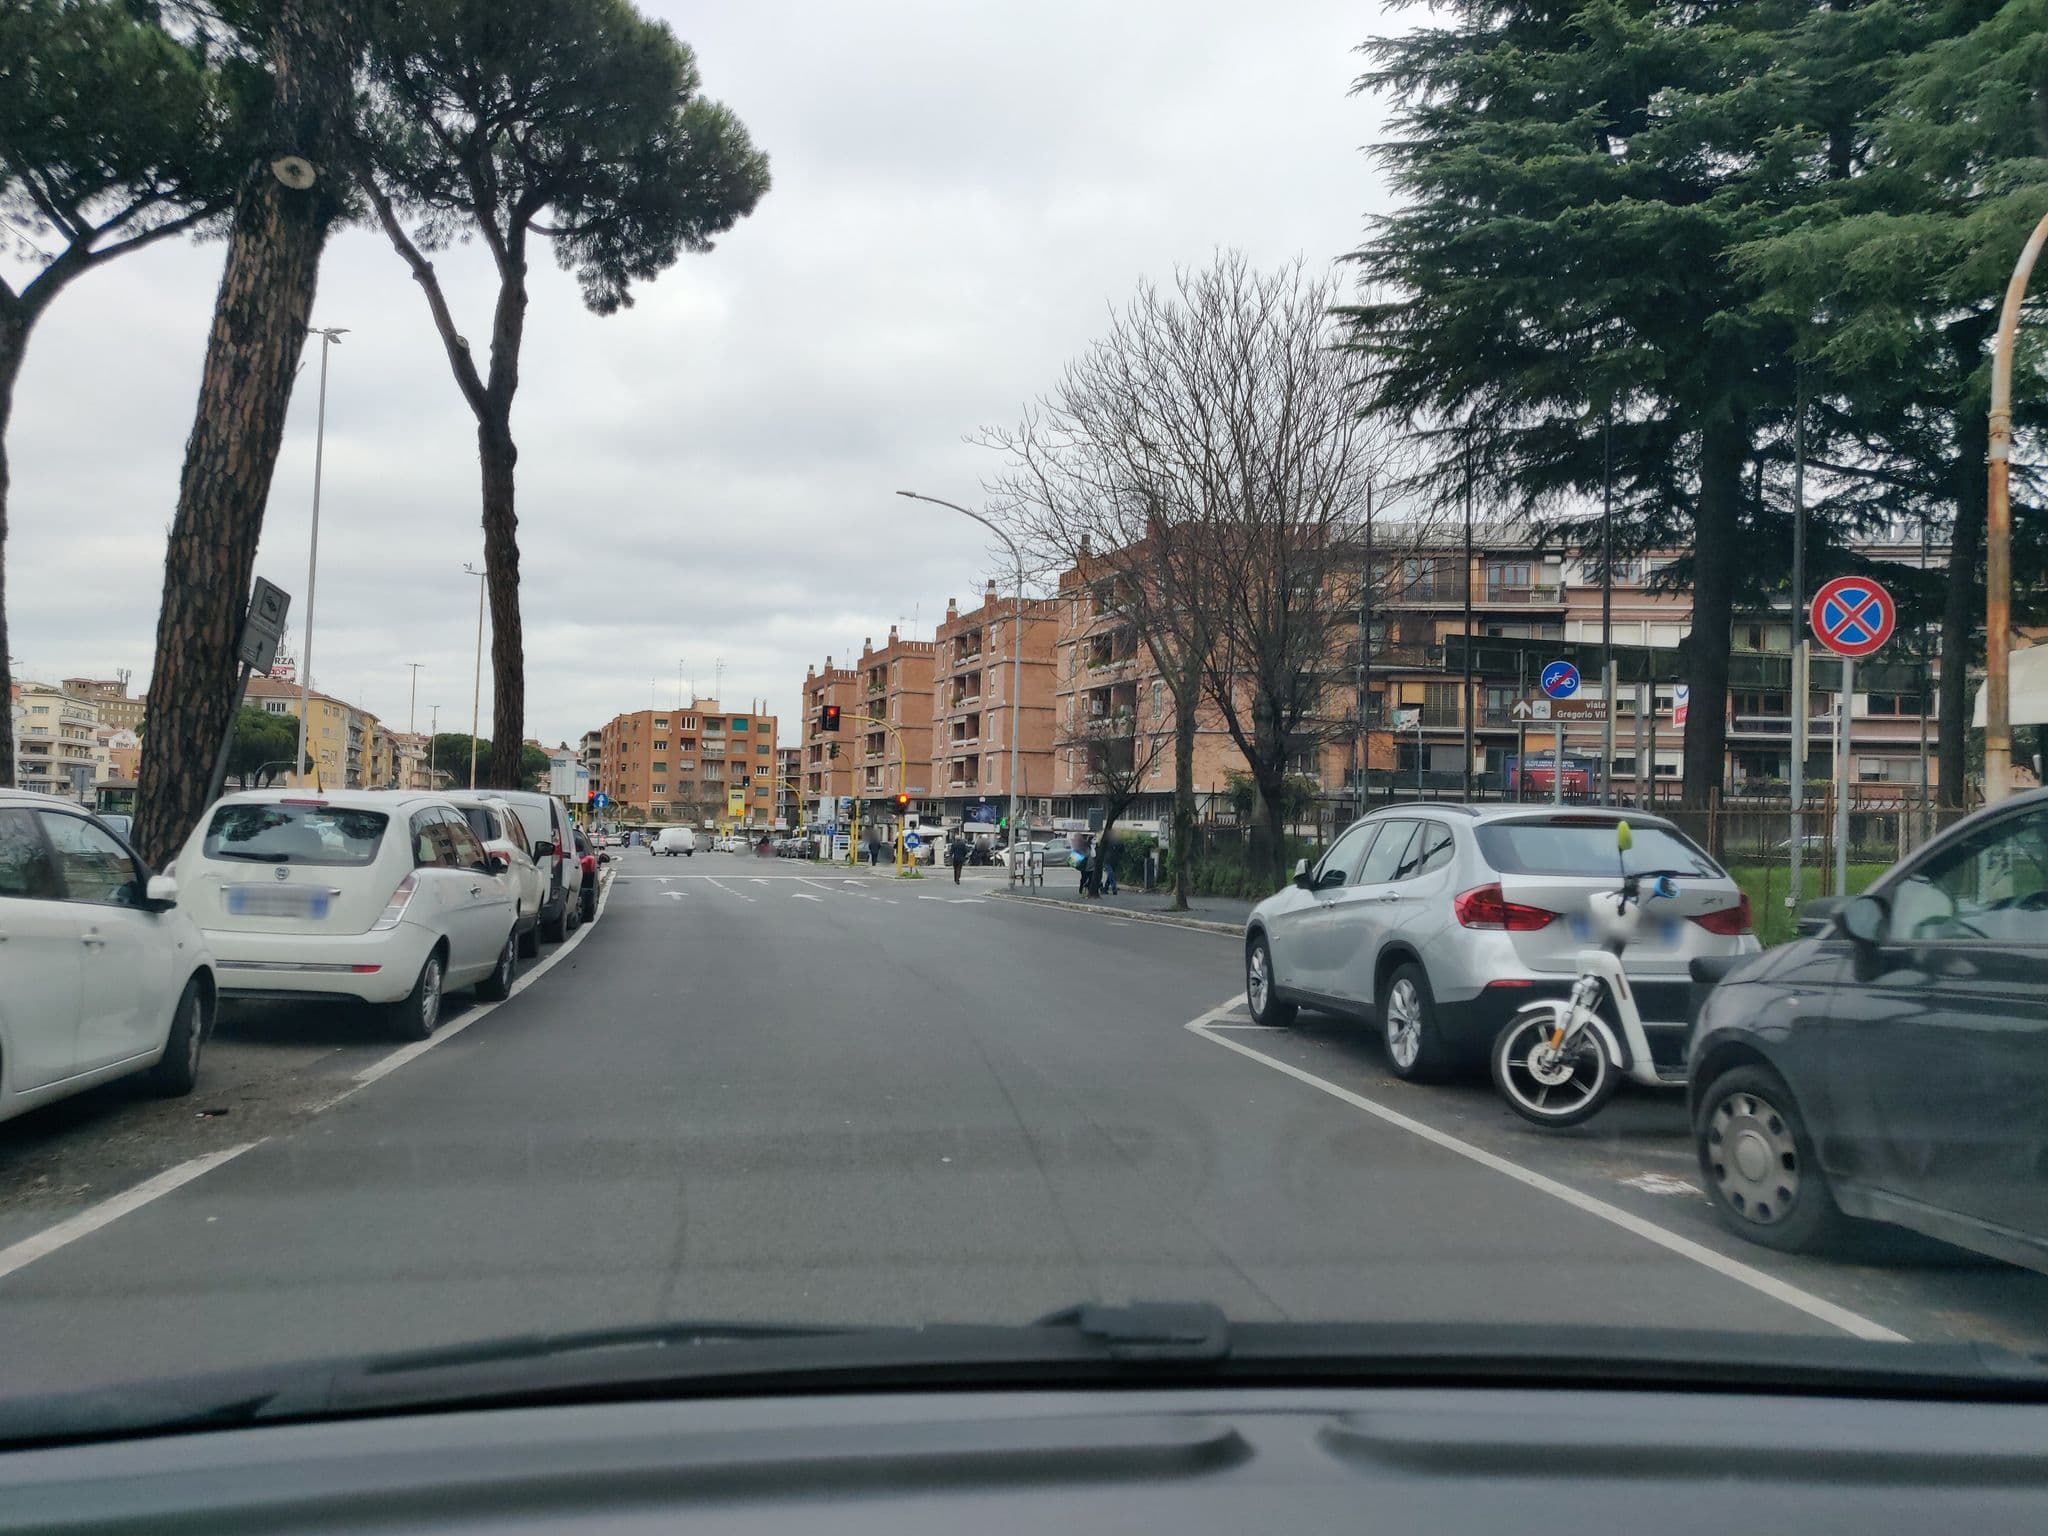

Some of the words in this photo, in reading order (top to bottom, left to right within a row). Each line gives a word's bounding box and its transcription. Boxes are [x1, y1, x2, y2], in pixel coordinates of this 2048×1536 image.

[1586, 700, 1606, 709] viale
[1557, 710, 1593, 719] Gregorio
[1703, 897, 1723, 905] X1
